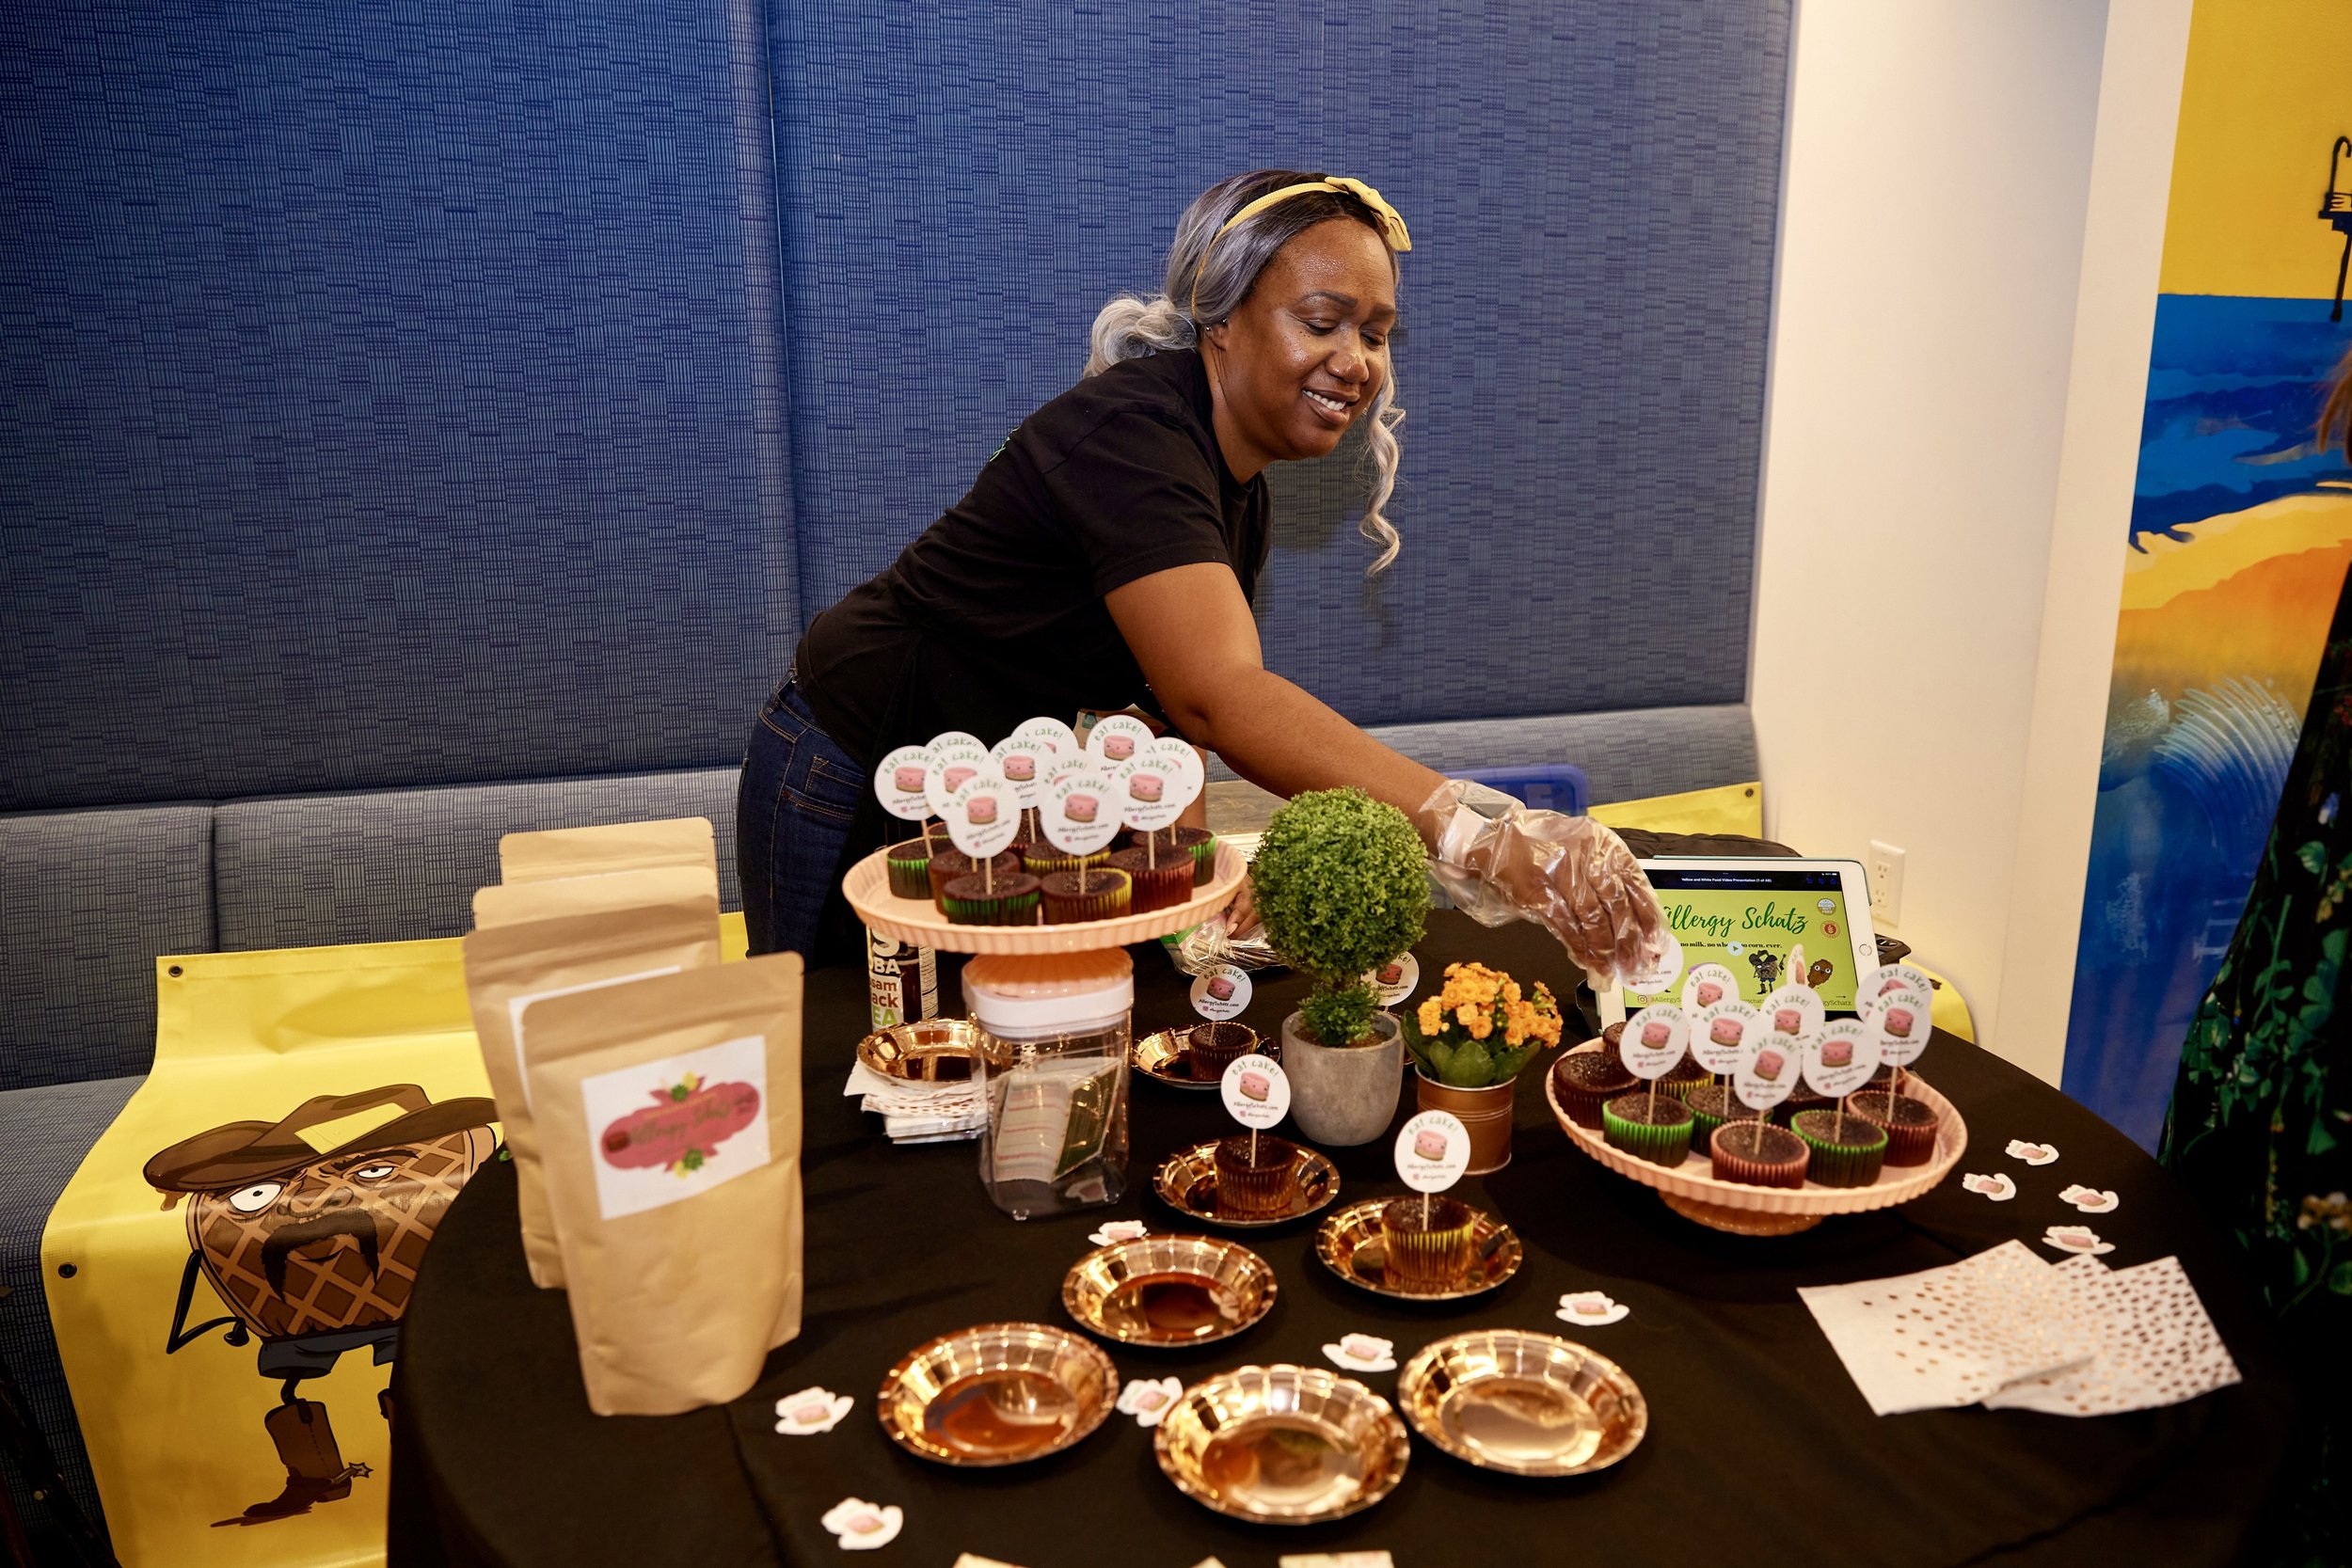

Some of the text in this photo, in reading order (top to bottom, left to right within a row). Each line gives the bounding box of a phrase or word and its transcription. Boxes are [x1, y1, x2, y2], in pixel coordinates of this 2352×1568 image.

[1741, 901, 1808, 934] Schatz
[1204, 968, 1247, 982] eat cake!
[1232, 1060, 1279, 1078] eat cake!
